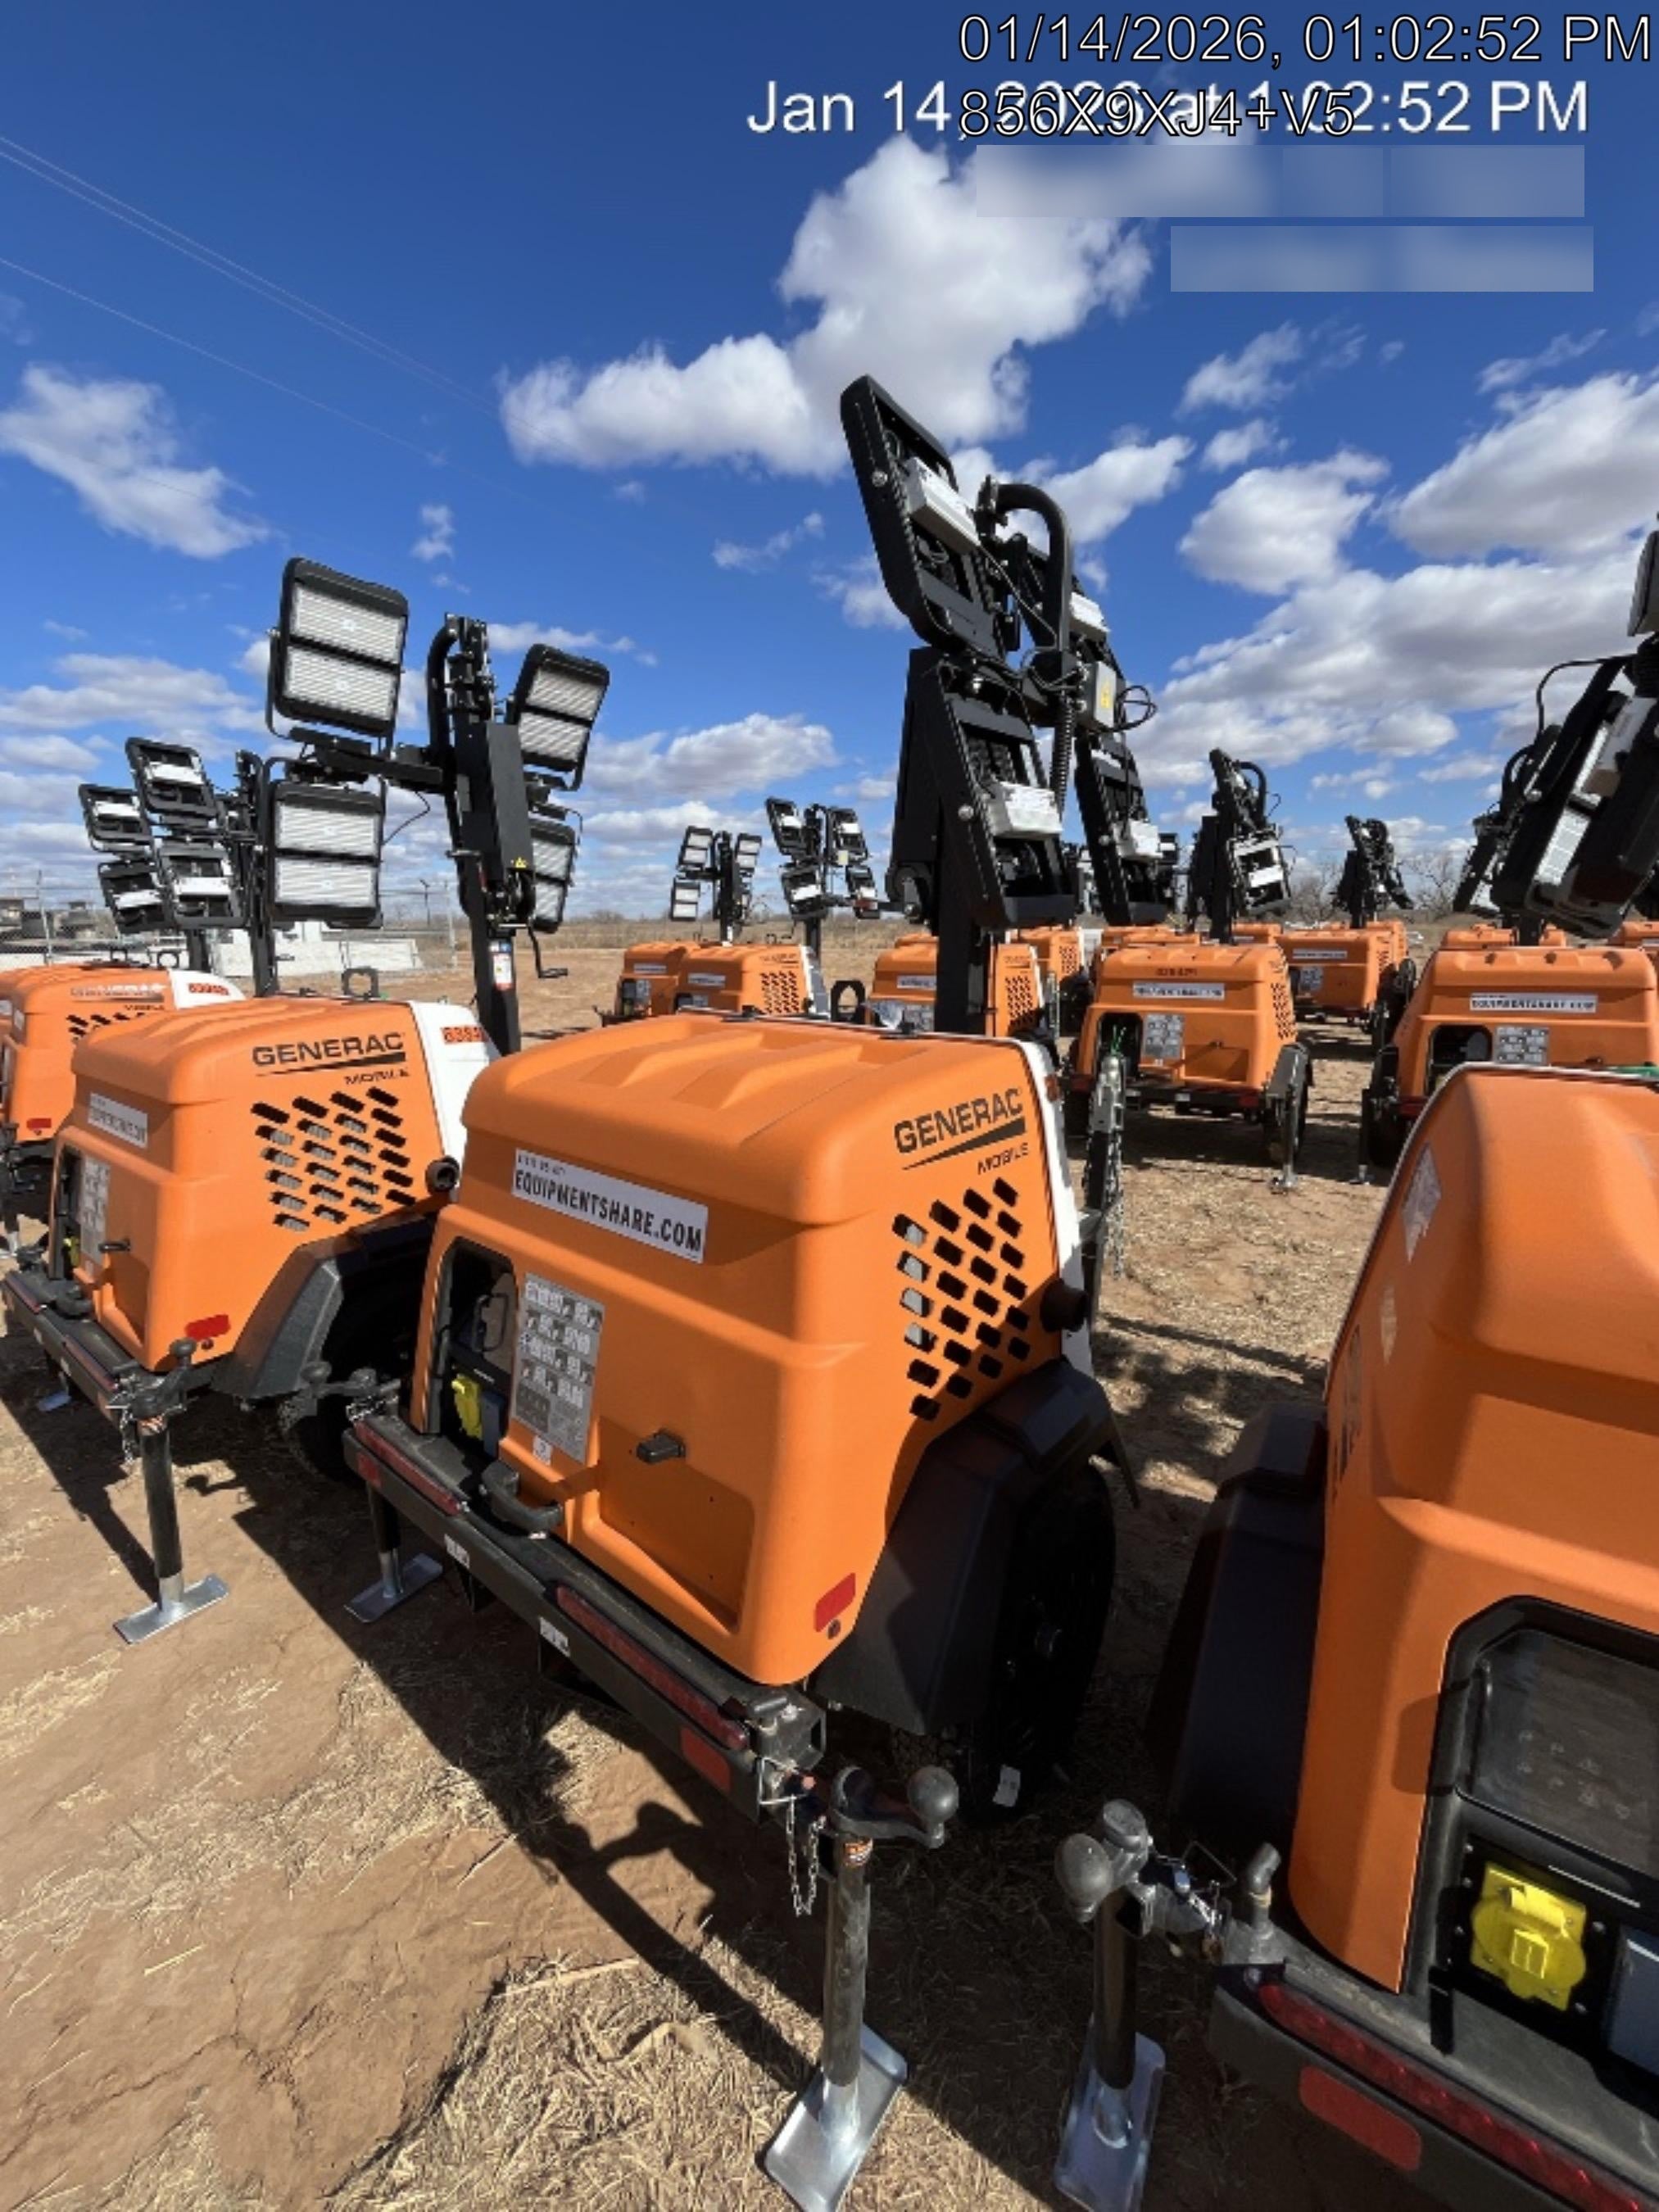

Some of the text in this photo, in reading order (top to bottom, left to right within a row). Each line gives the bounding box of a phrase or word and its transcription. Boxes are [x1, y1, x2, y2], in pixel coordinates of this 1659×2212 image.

[252, 1032, 404, 1066] GENERAC
[895, 1087, 1023, 1154] GENERAC
[977, 1142, 1029, 1175] MOBILE
[514, 1169, 702, 1253] EQUIPMENTSHARE.COM
